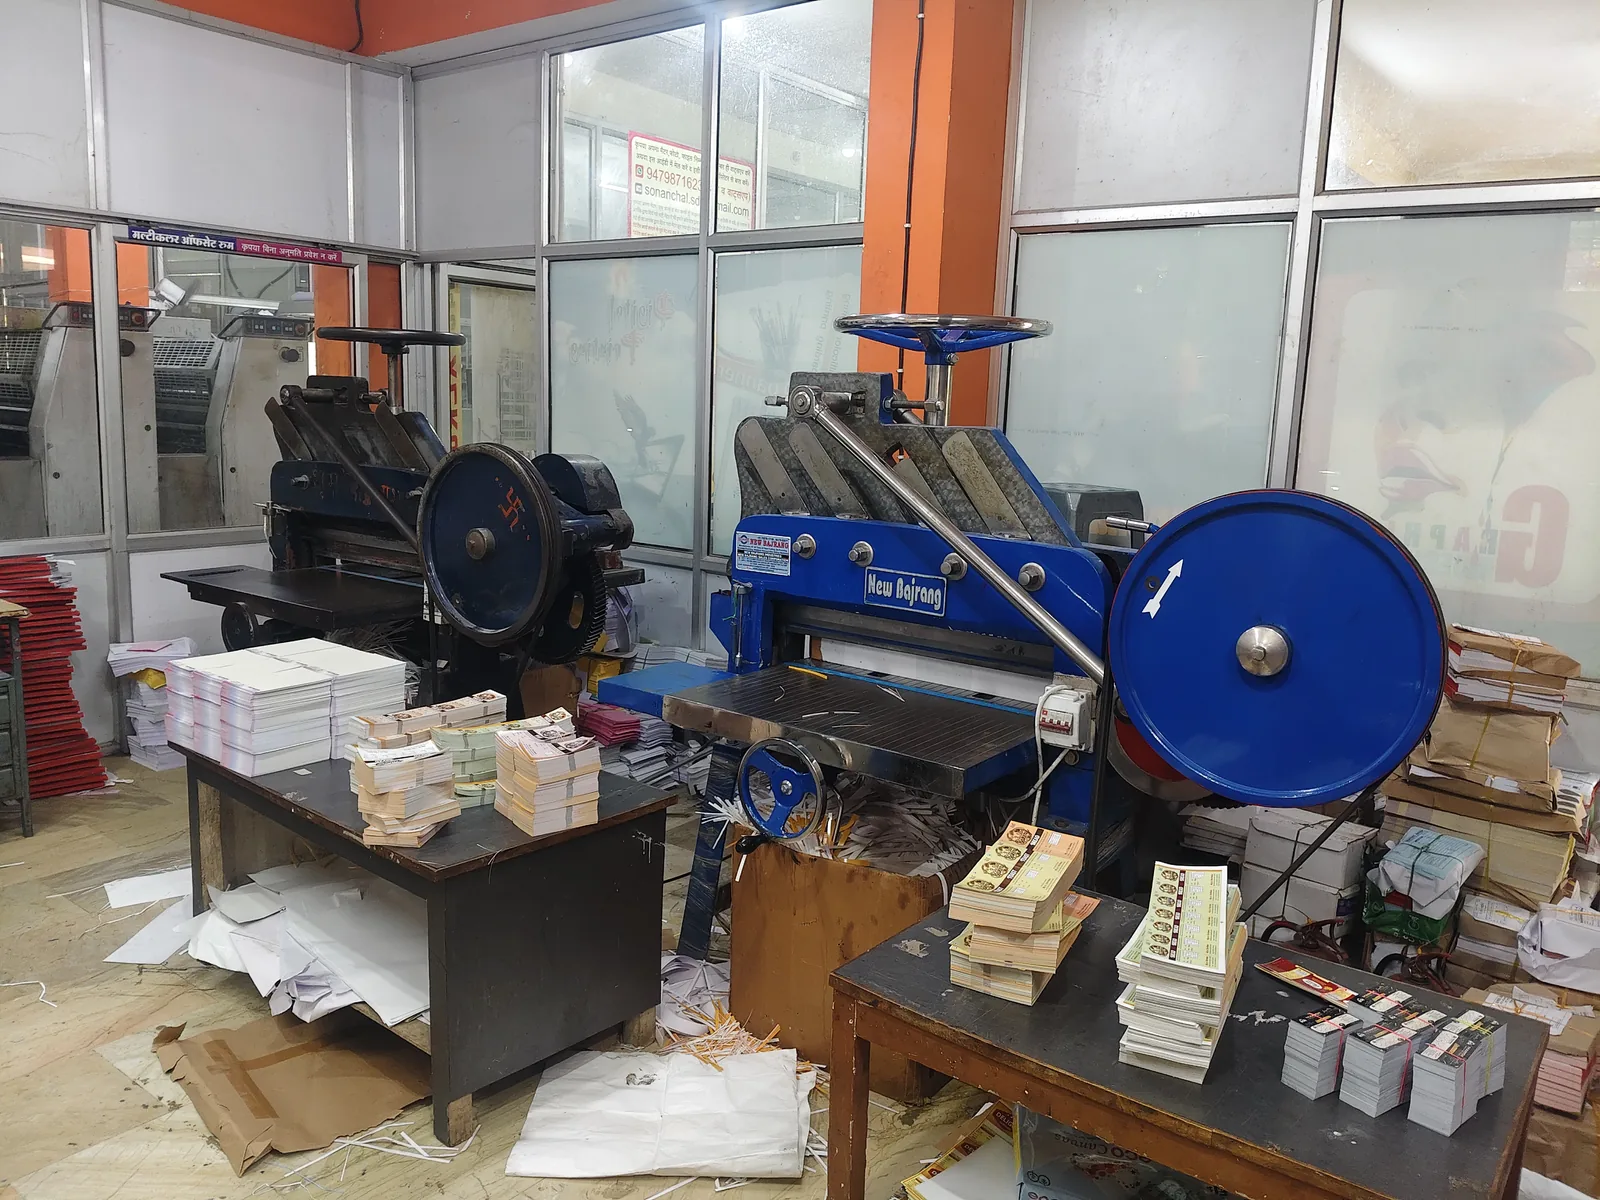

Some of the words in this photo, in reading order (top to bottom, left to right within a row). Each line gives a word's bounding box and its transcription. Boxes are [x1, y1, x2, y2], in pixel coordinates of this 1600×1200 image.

[132, 229, 180, 244] मल्टीकलर
[181, 234, 217, 248] ऑफसेट
[241, 243, 261, 252] कृपया
[262, 243, 277, 254] बिना
[279, 247, 302, 257] अनुमति
[303, 250, 319, 259] प्रवेश
[328, 253, 338, 261] करें
[763, 540, 789, 549] BAJRANG
[867, 572, 894, 598] New
[895, 577, 942, 610] Bajrang
